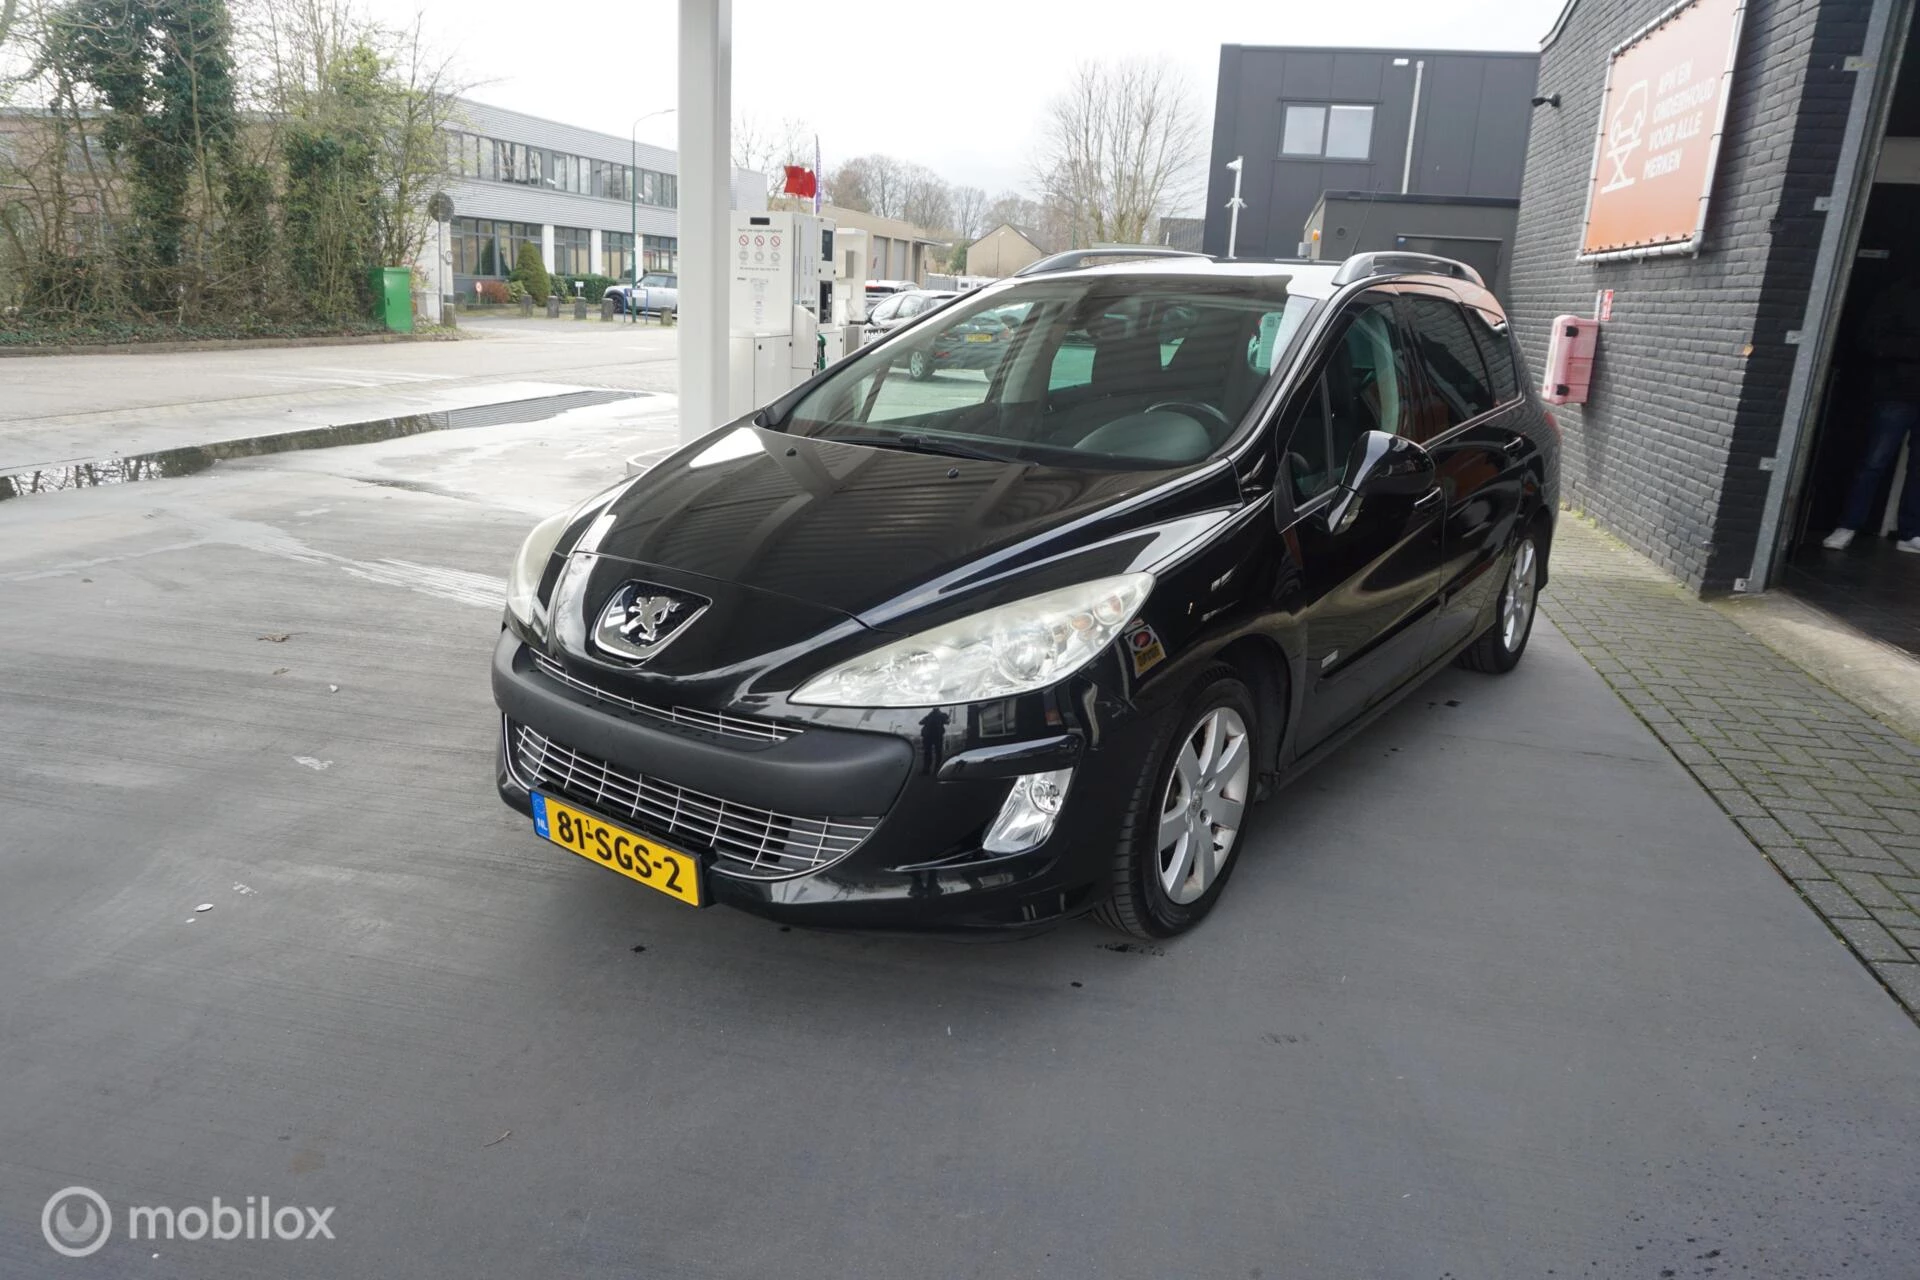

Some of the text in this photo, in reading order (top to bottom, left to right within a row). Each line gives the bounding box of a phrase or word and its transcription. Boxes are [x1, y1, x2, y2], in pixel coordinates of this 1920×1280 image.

[1648, 110, 1703, 152] VOOR ALLE
[1643, 147, 1682, 180] MERKEN
[537, 818, 548, 831] NL
[557, 810, 683, 893] 81-SGS-2
